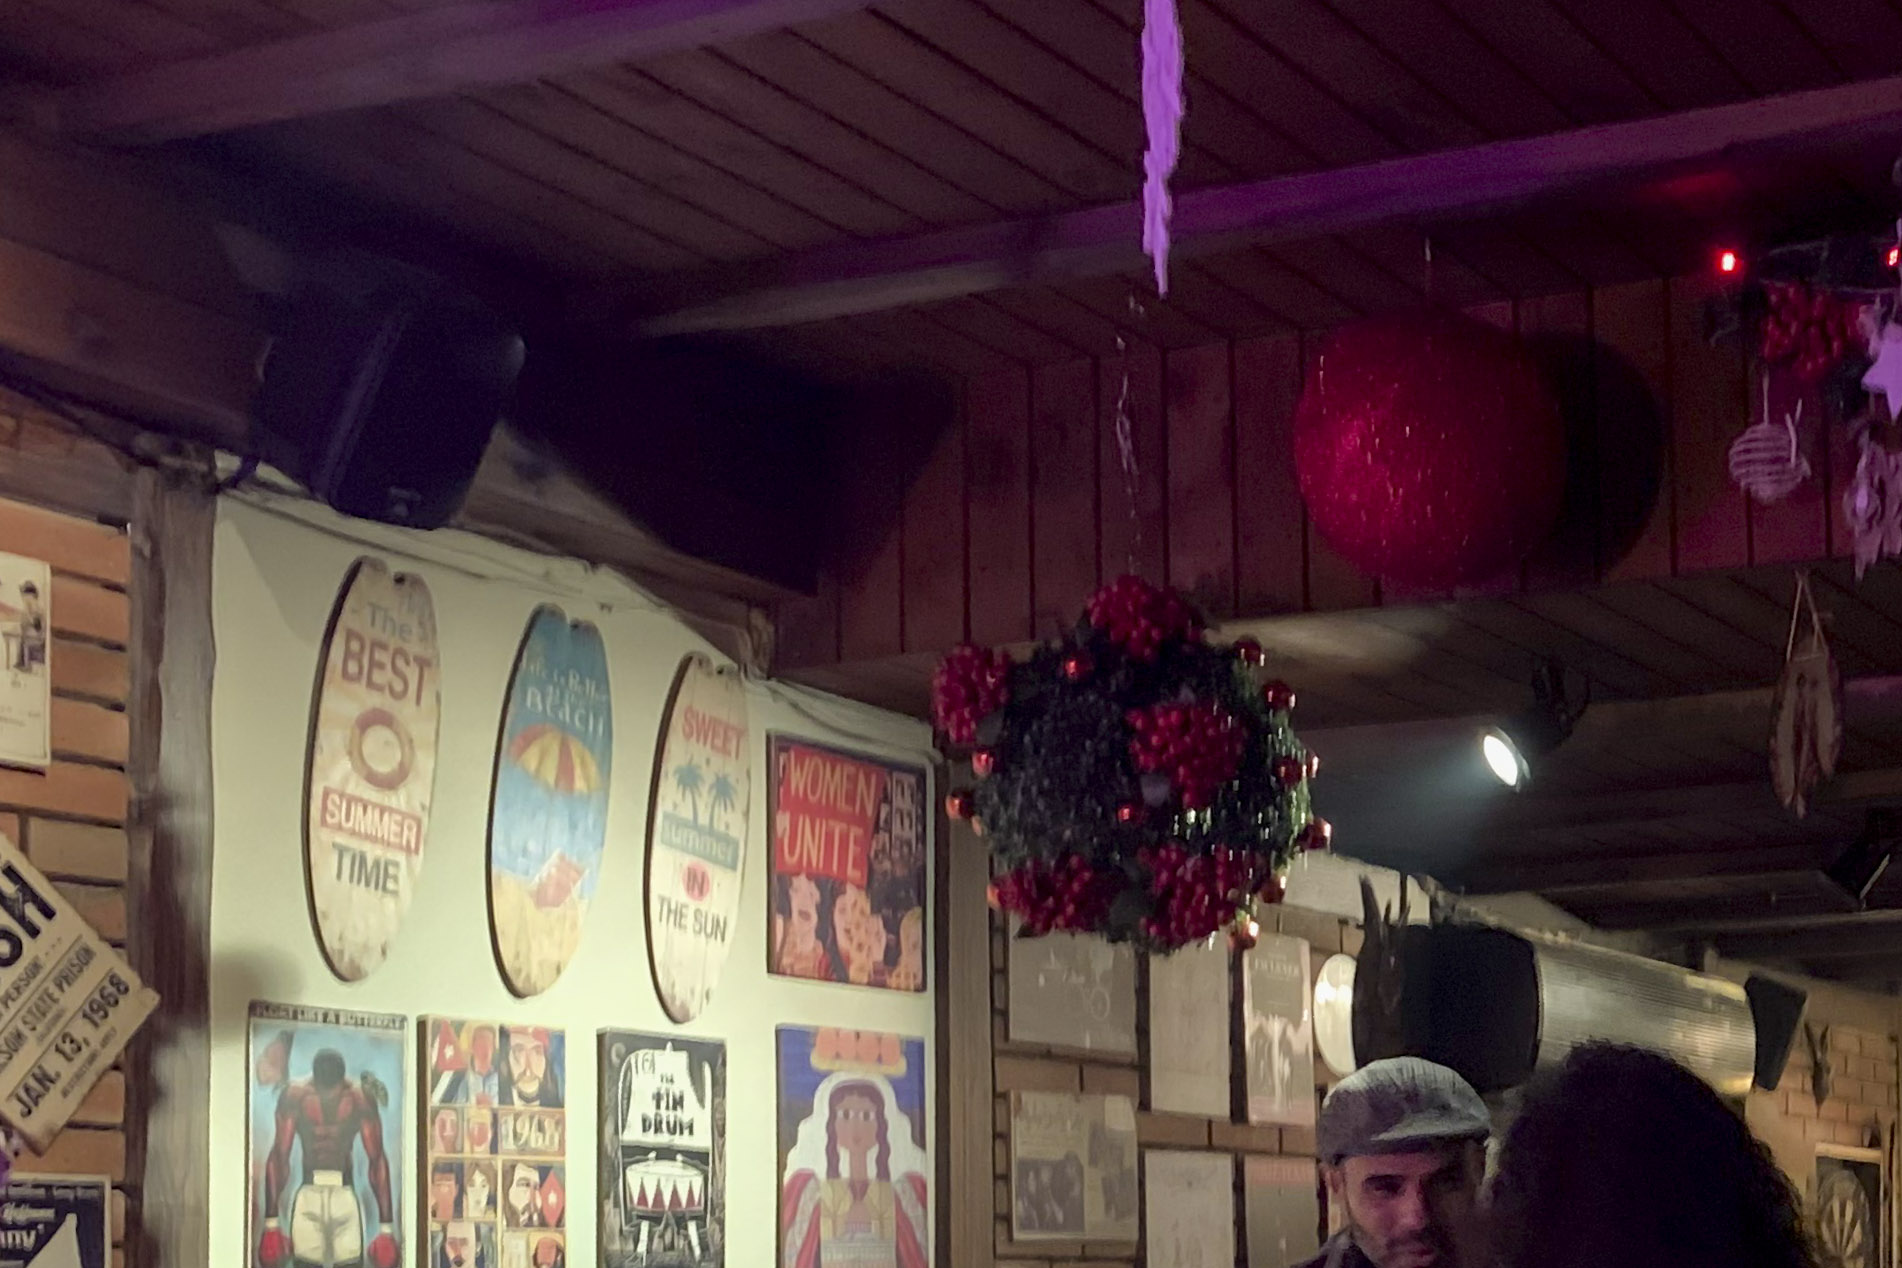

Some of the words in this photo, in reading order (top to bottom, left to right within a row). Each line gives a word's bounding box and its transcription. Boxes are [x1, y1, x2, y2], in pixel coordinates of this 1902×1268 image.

[367, 602, 413, 642] The
[340, 633, 433, 708] BEST
[681, 704, 746, 760] SWEET
[789, 748, 877, 818] WOMEN
[324, 801, 419, 852] SUMMER
[783, 813, 865, 881] UNITE
[331, 841, 402, 897] TIME
[686, 867, 708, 897] IN
[656, 899, 691, 932] THE
[692, 909, 728, 943] SUN
[51, 940, 97, 995] PRISON
[12, 1064, 62, 1119] JAN.
[54, 1030, 91, 1064] 13,
[81, 971, 130, 1030] 1968
[641, 1112, 695, 1137] DRUM
[652, 1086, 685, 1112] TIN
